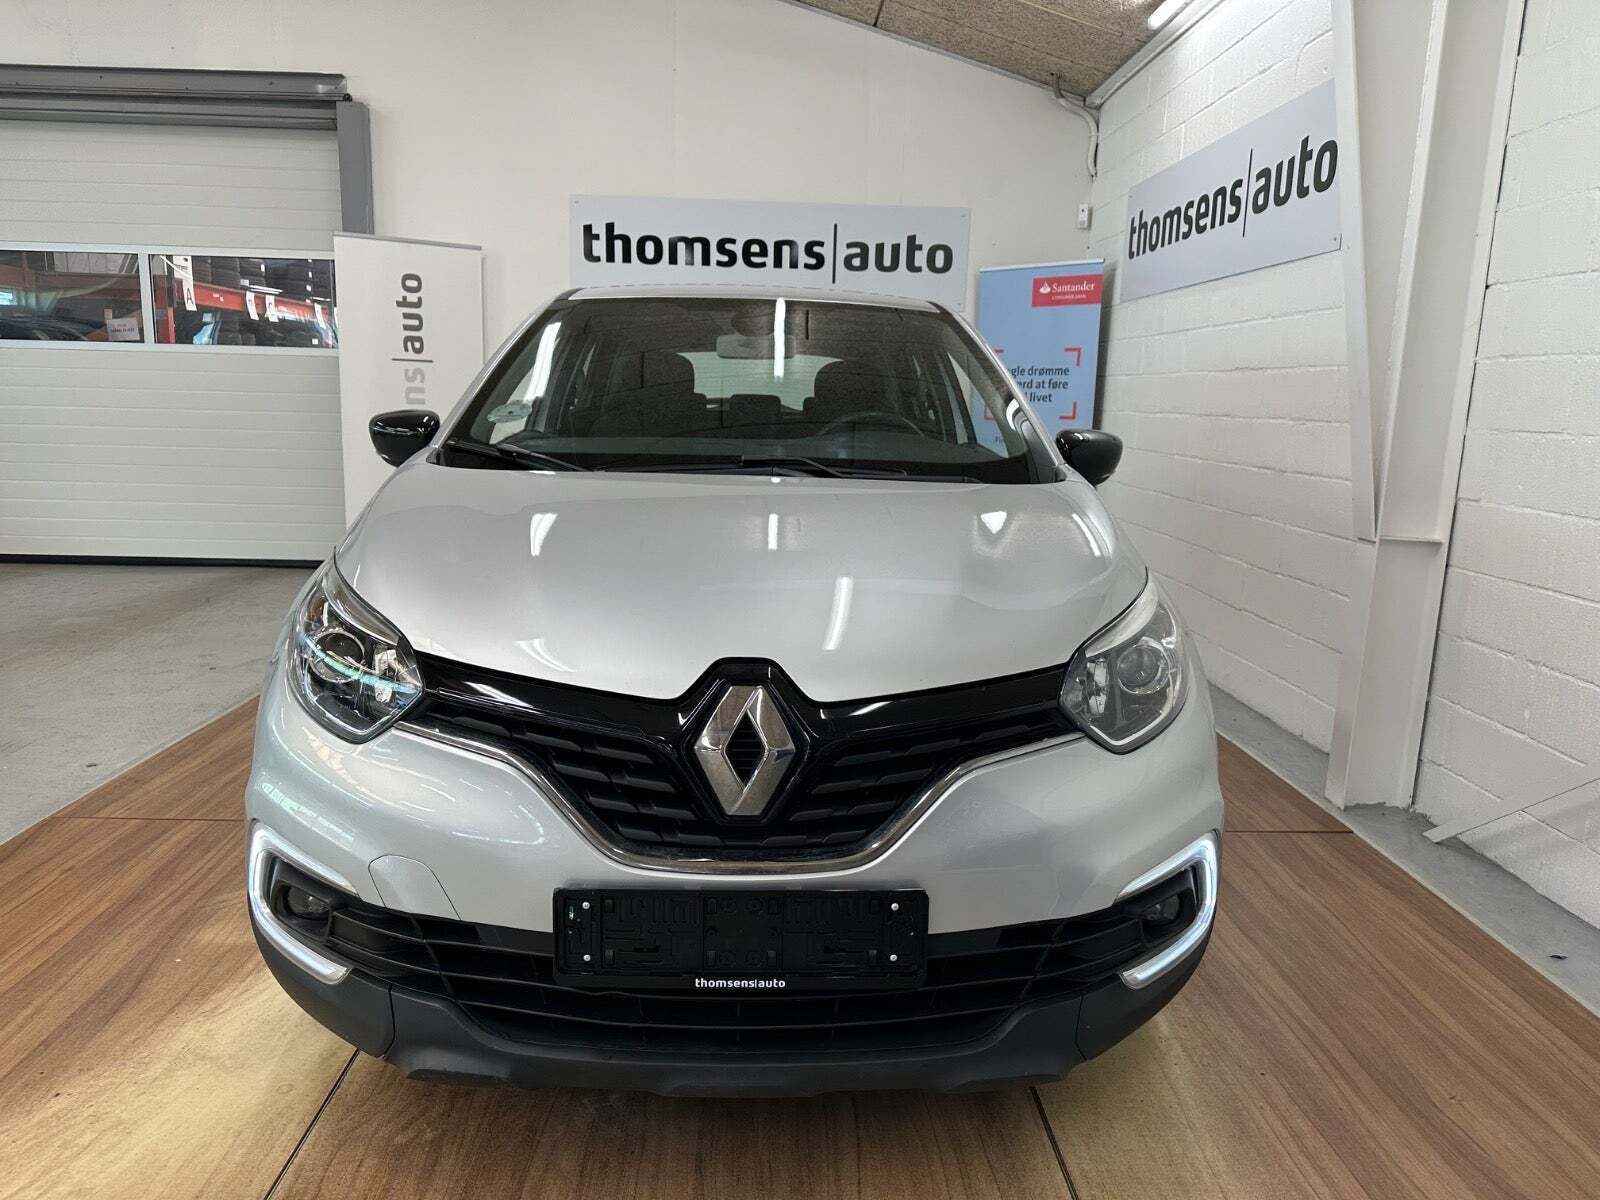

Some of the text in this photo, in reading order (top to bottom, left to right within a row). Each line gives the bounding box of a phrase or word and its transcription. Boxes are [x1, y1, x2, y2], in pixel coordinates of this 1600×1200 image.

[1052, 280, 1095, 293] Santander
[1010, 365, 1070, 378] gle drømme
[1035, 380, 1046, 389] at
[1048, 378, 1069, 389] føre
[1029, 391, 1053, 402] livet
